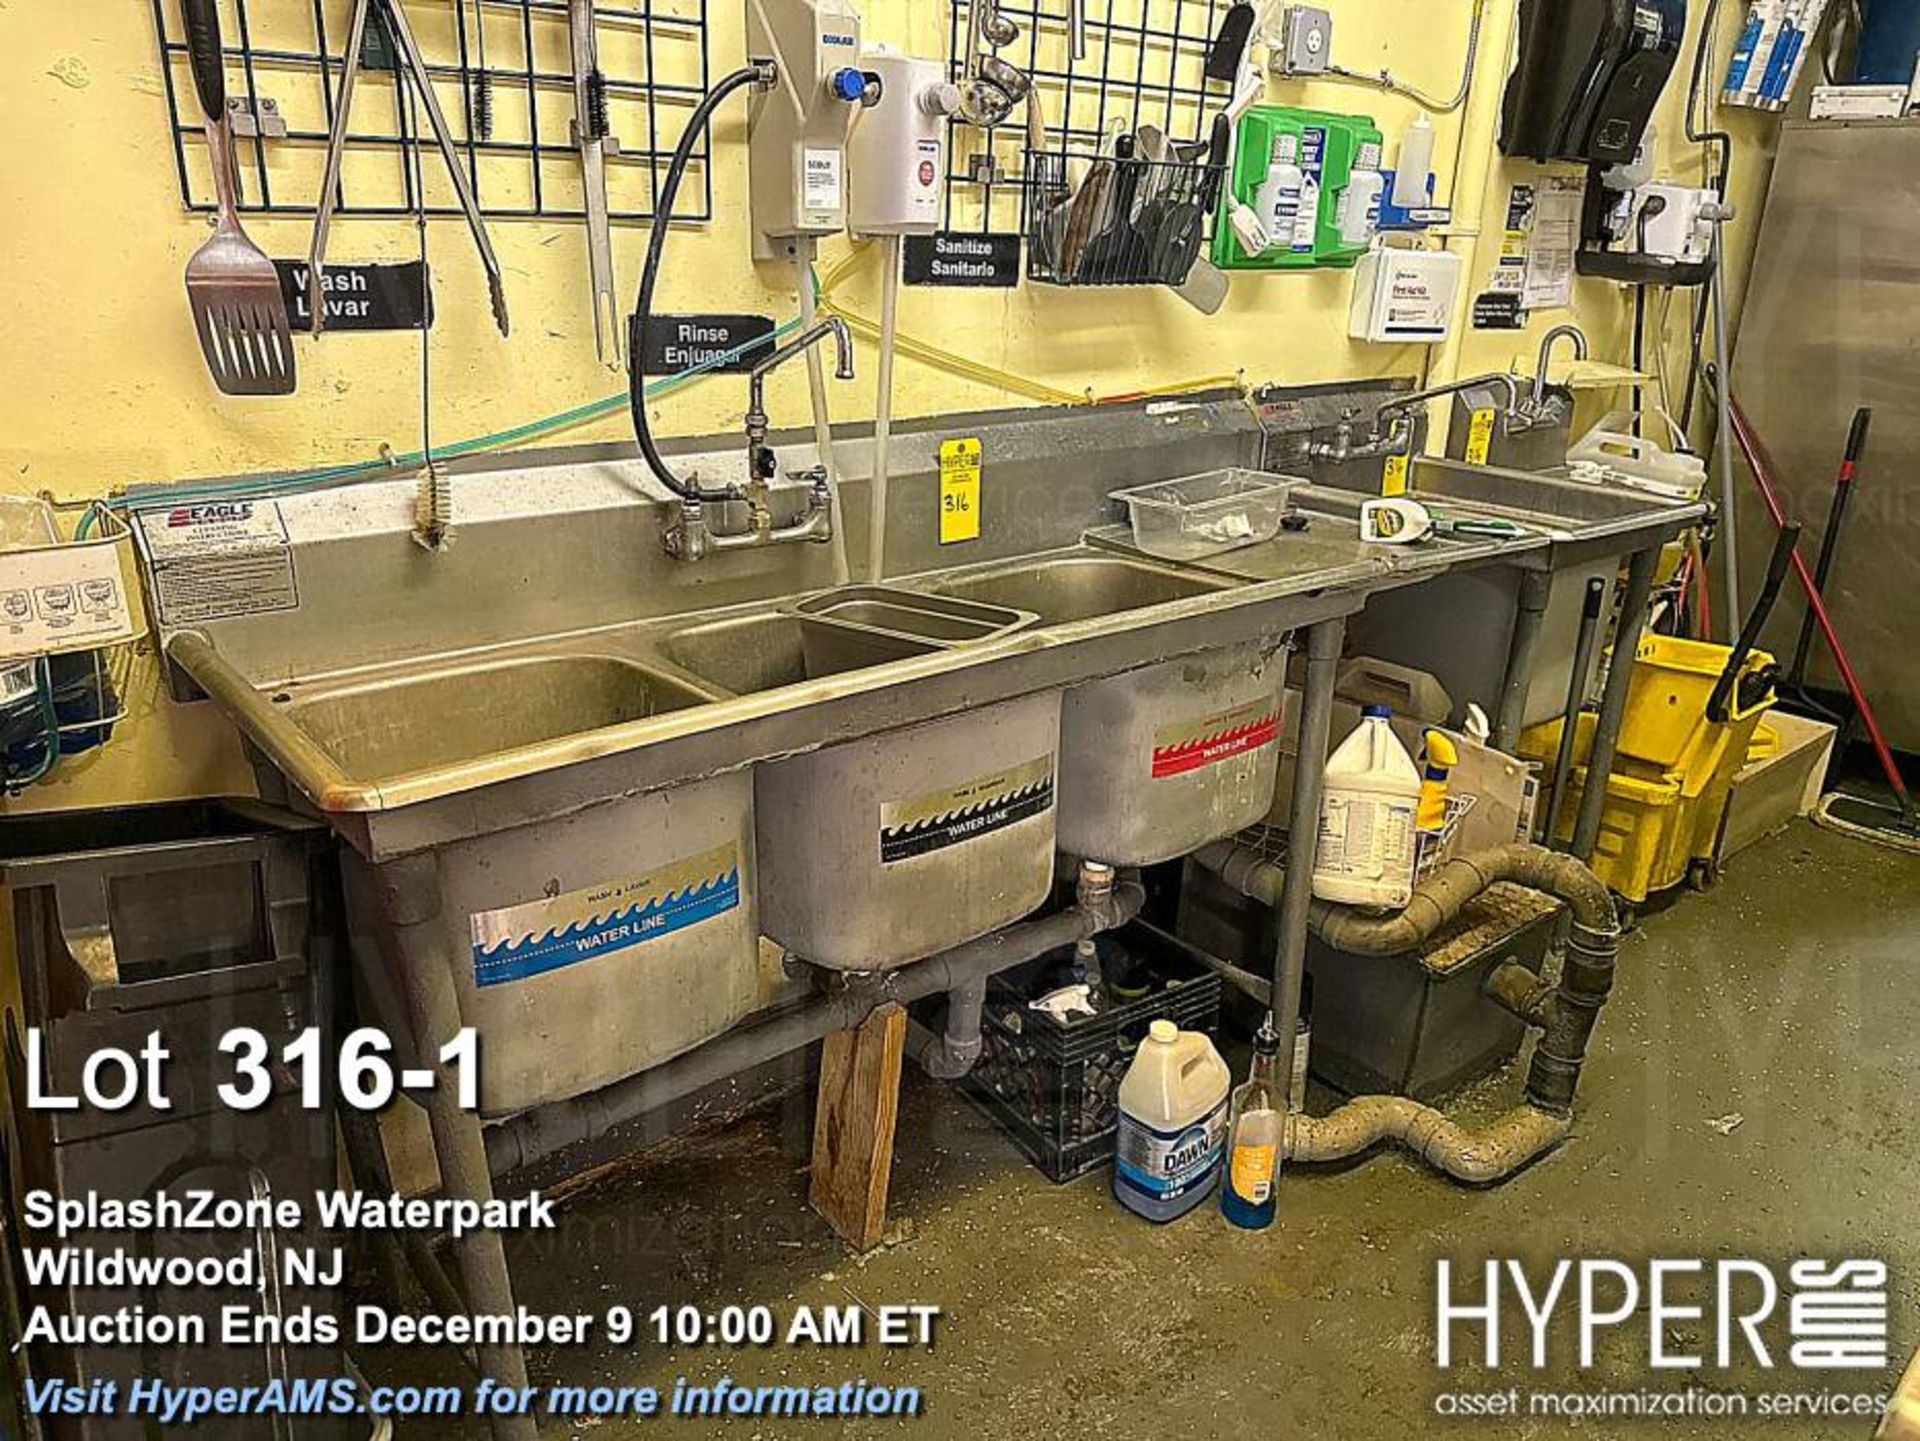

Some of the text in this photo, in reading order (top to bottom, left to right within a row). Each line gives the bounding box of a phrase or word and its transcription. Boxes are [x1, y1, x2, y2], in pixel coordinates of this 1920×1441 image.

[935, 238, 993, 255] Sanitize
[931, 260, 995, 276] Sanitario
[295, 296, 370, 316] Lvar
[678, 324, 729, 342] Rinse
[190, 502, 253, 520] EAGLE
[944, 492, 969, 512] 316
[946, 816, 985, 837] WATER
[575, 914, 666, 952] WATER LINE
[1164, 1134, 1208, 1172] DAWN
